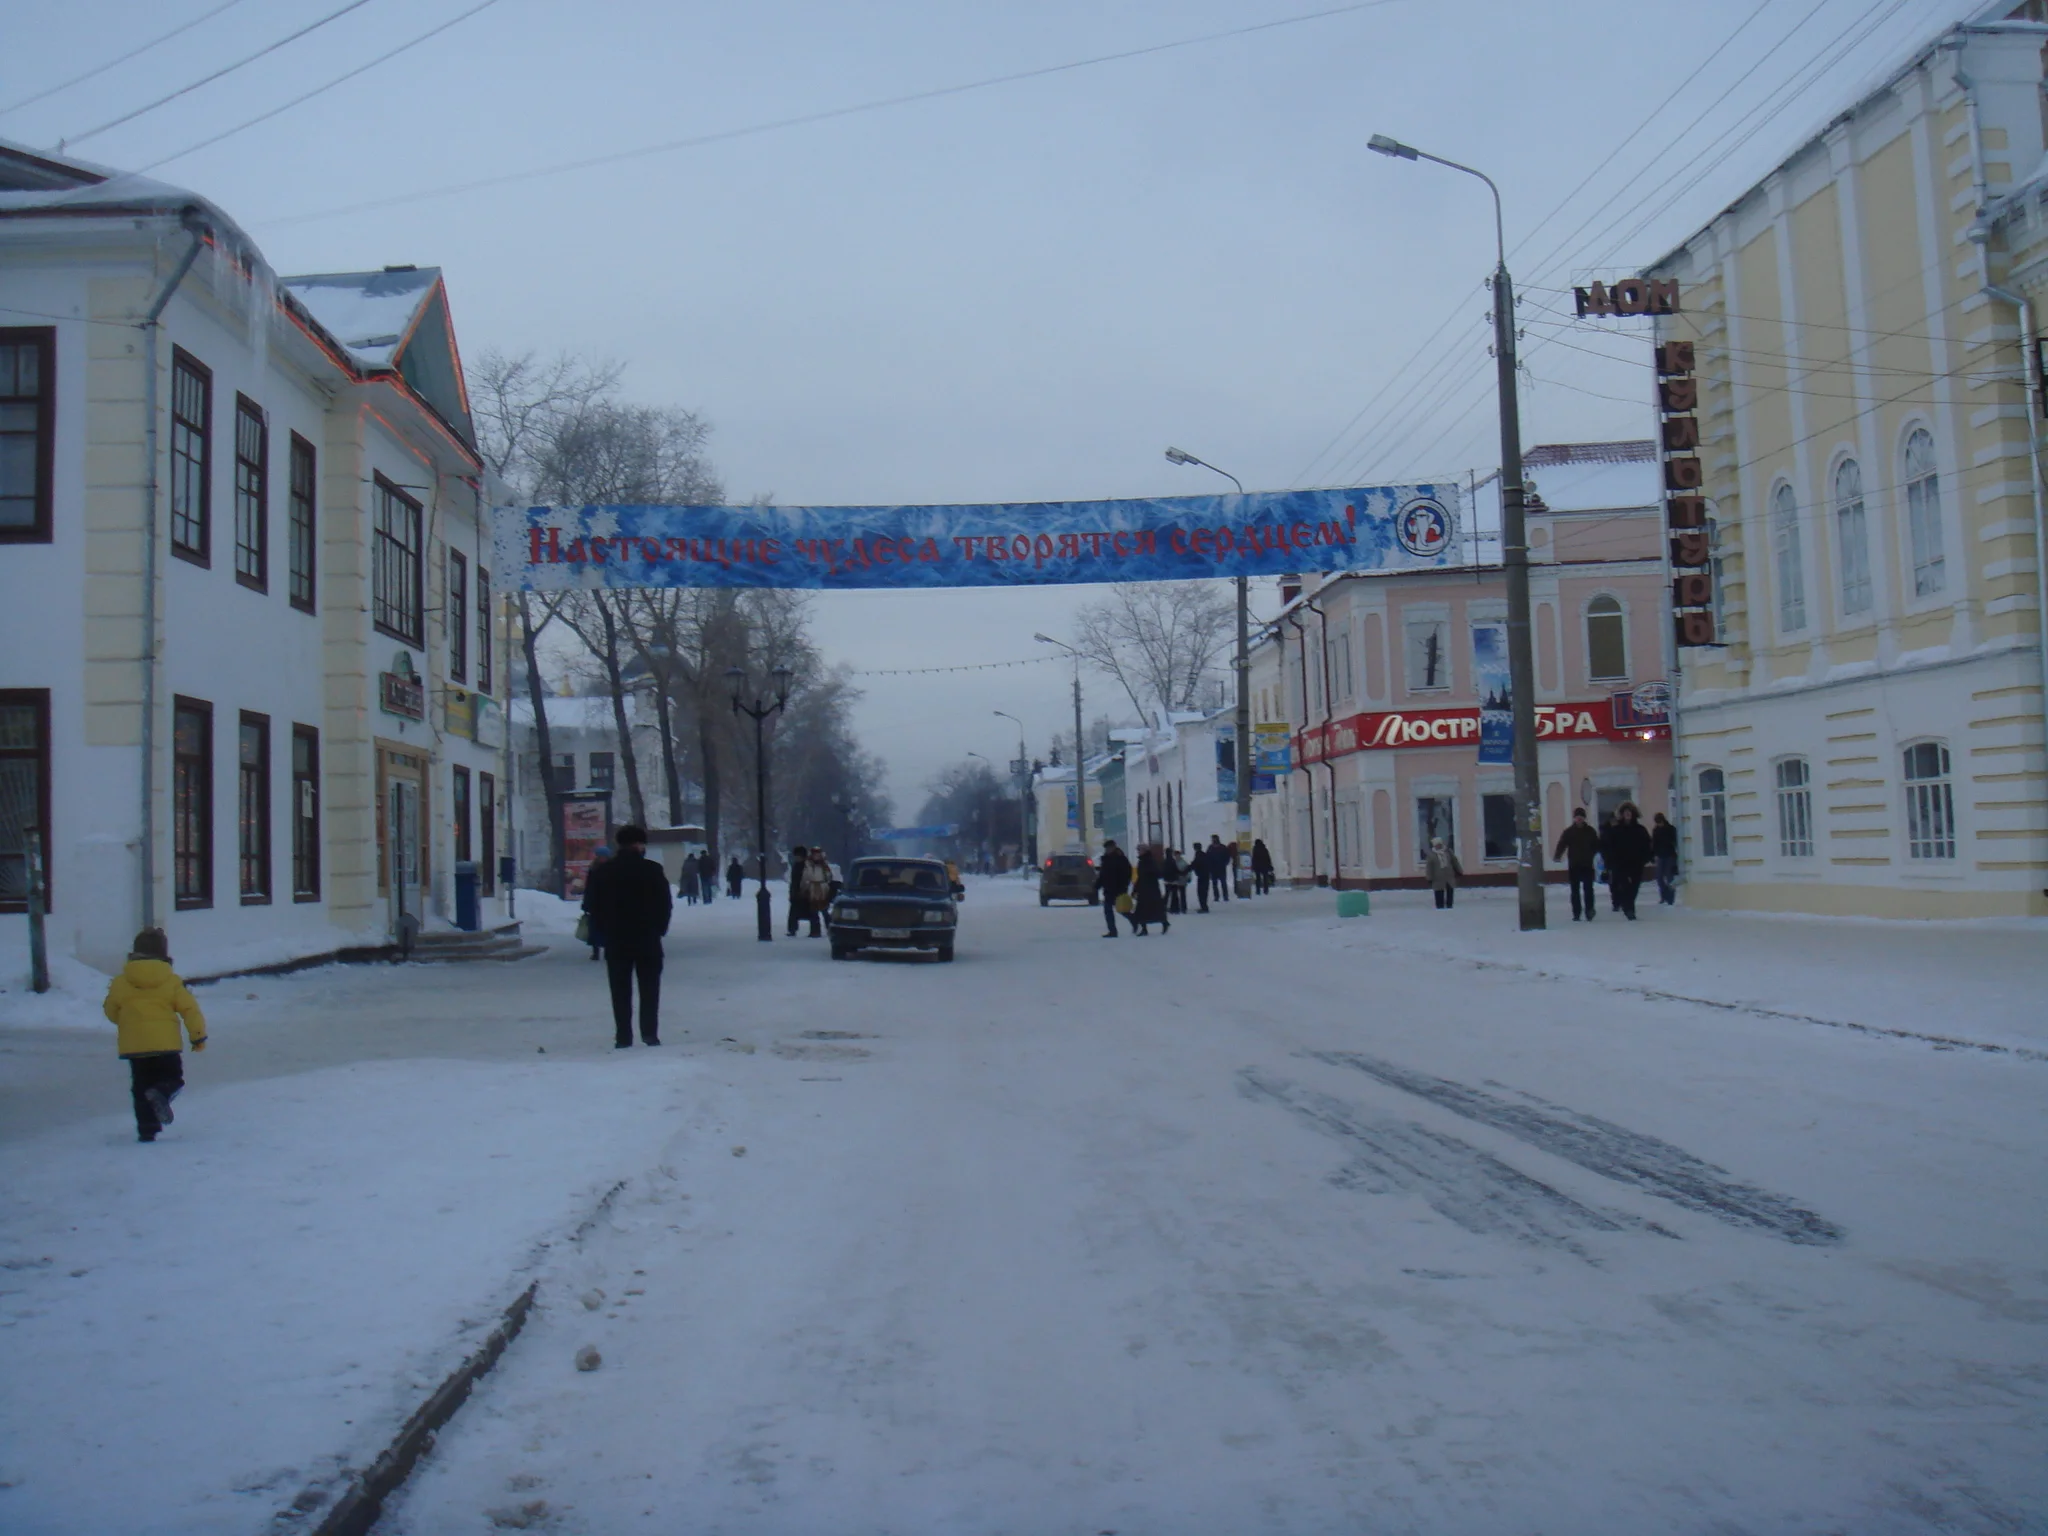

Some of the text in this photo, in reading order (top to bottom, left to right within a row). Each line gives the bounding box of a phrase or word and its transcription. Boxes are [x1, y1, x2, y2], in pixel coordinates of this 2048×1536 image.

[1582, 278, 1680, 316] ДОМ
[1657, 340, 1714, 647] КУЛЬТУРЫ
[527, 527, 782, 570] Настоящие
[795, 536, 941, 575] чудеса
[953, 530, 1156, 570] творятся
[1171, 504, 1357, 564] сердцем!
